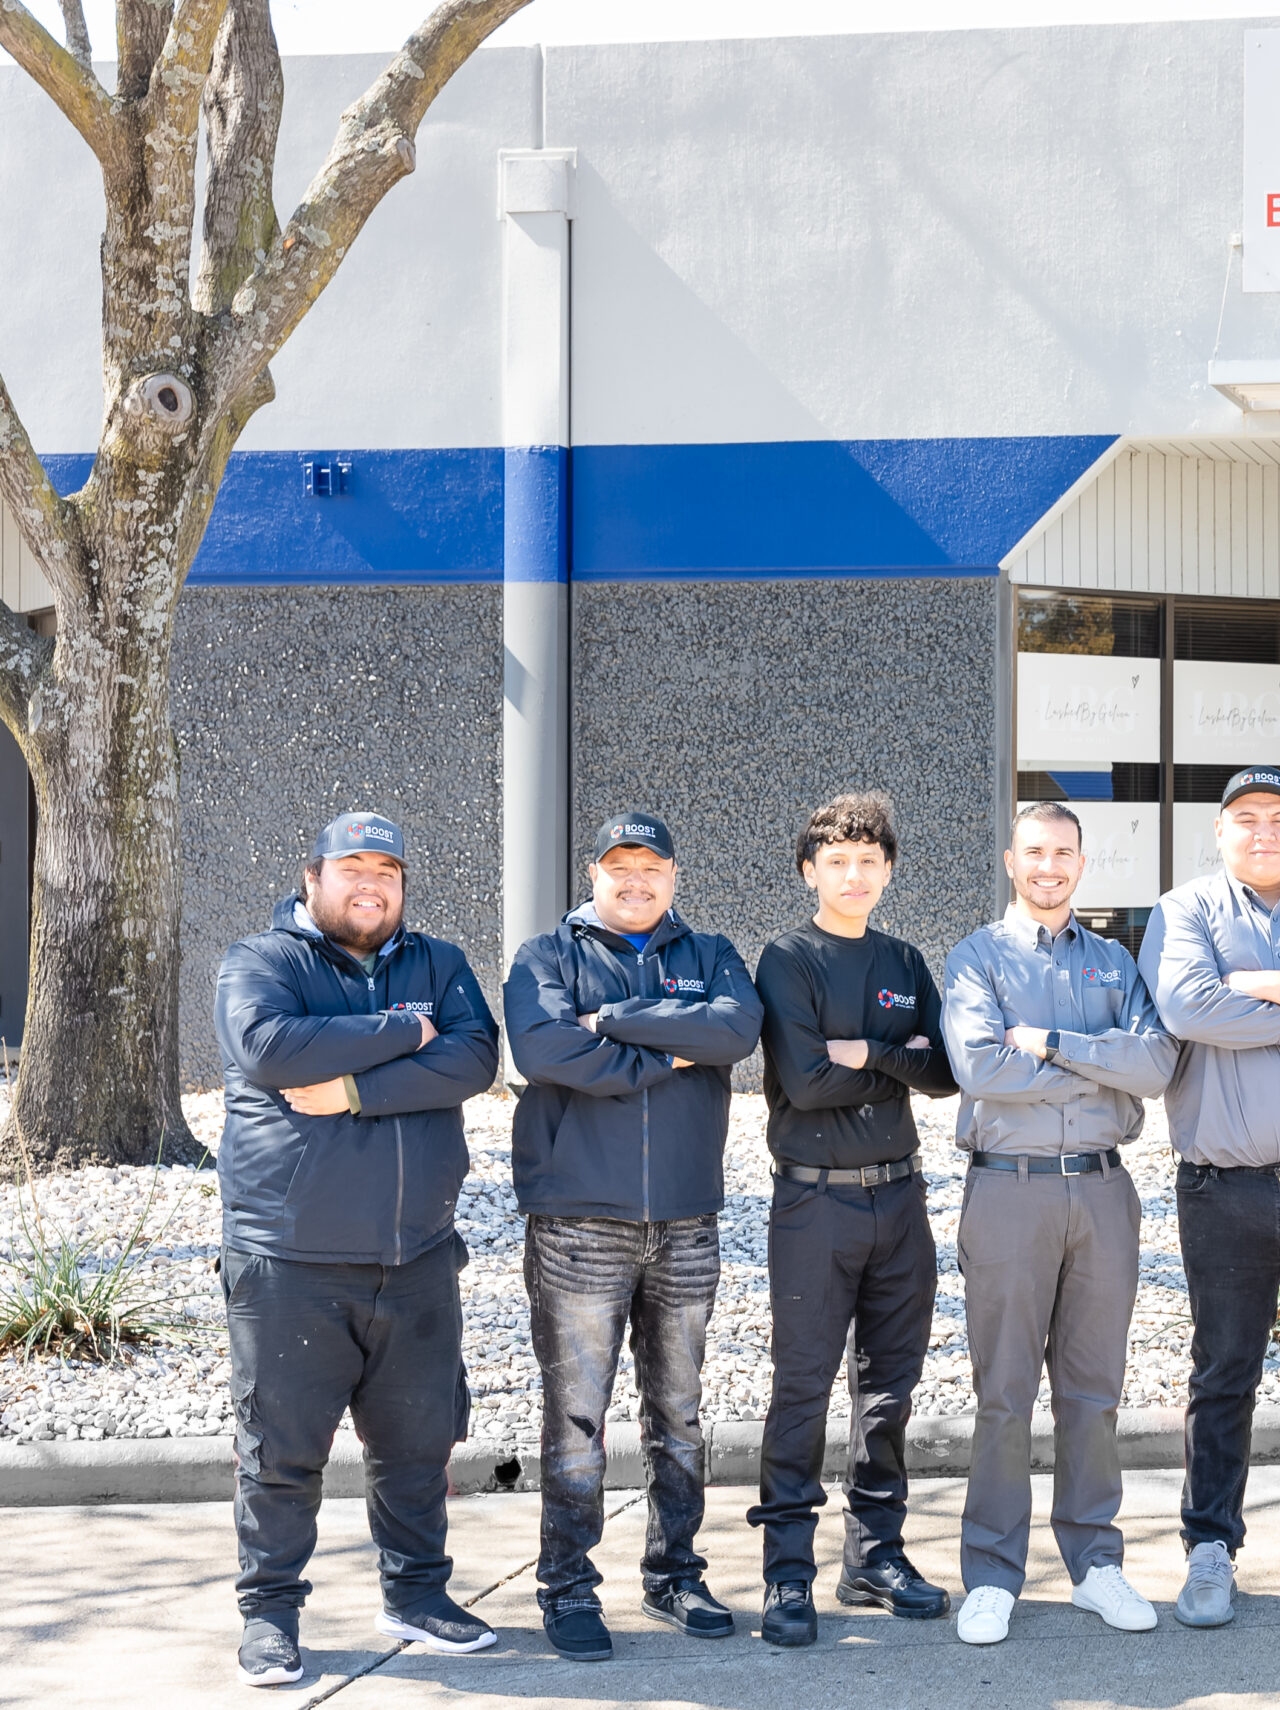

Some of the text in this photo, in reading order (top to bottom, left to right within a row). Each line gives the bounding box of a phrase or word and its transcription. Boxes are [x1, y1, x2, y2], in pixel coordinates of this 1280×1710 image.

[365, 826, 394, 839] BOOST
[625, 824, 656, 835] BOOST
[677, 979, 704, 989] BOOST
[893, 993, 916, 1005] BOOS
[405, 1002, 433, 1011] BOOST
